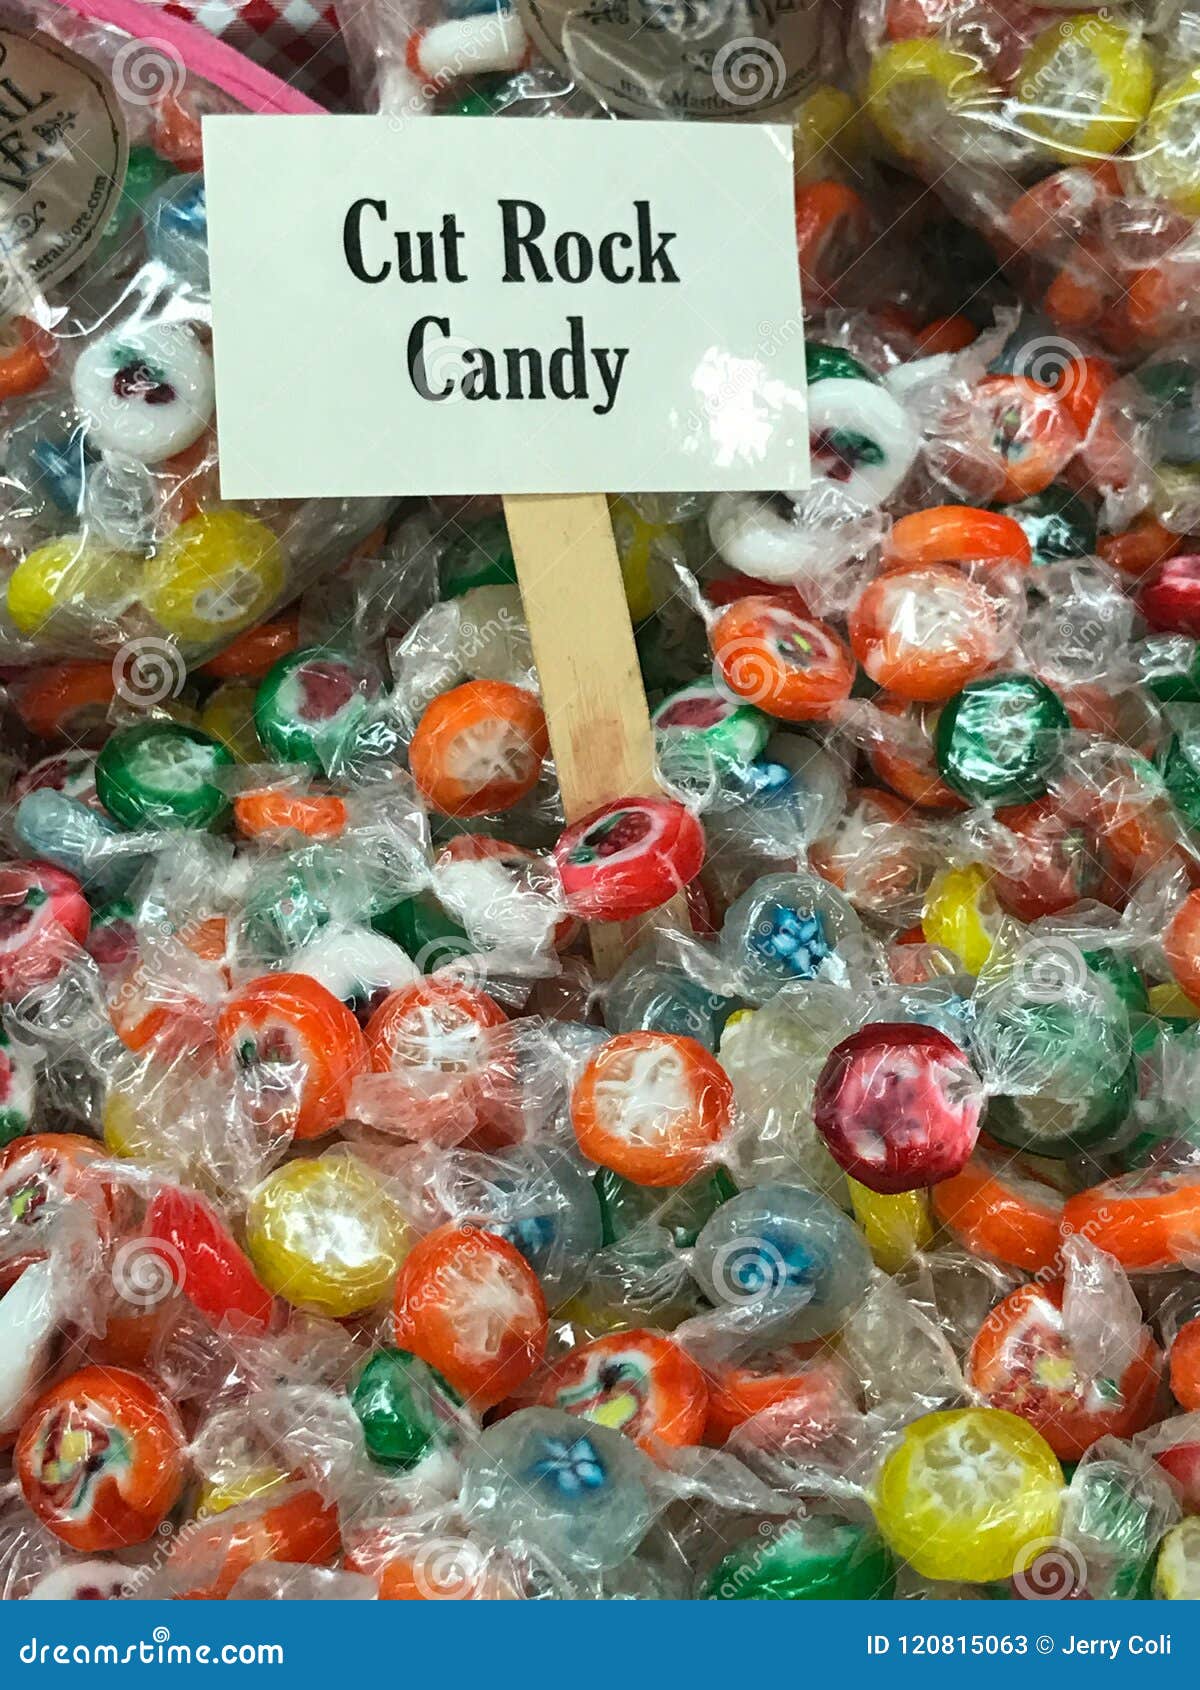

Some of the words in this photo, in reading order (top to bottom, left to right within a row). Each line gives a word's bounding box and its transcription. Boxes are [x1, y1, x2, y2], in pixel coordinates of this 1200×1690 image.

[343, 198, 468, 284] Cut
[497, 199, 681, 284] Rock
[407, 315, 630, 415] Candy
